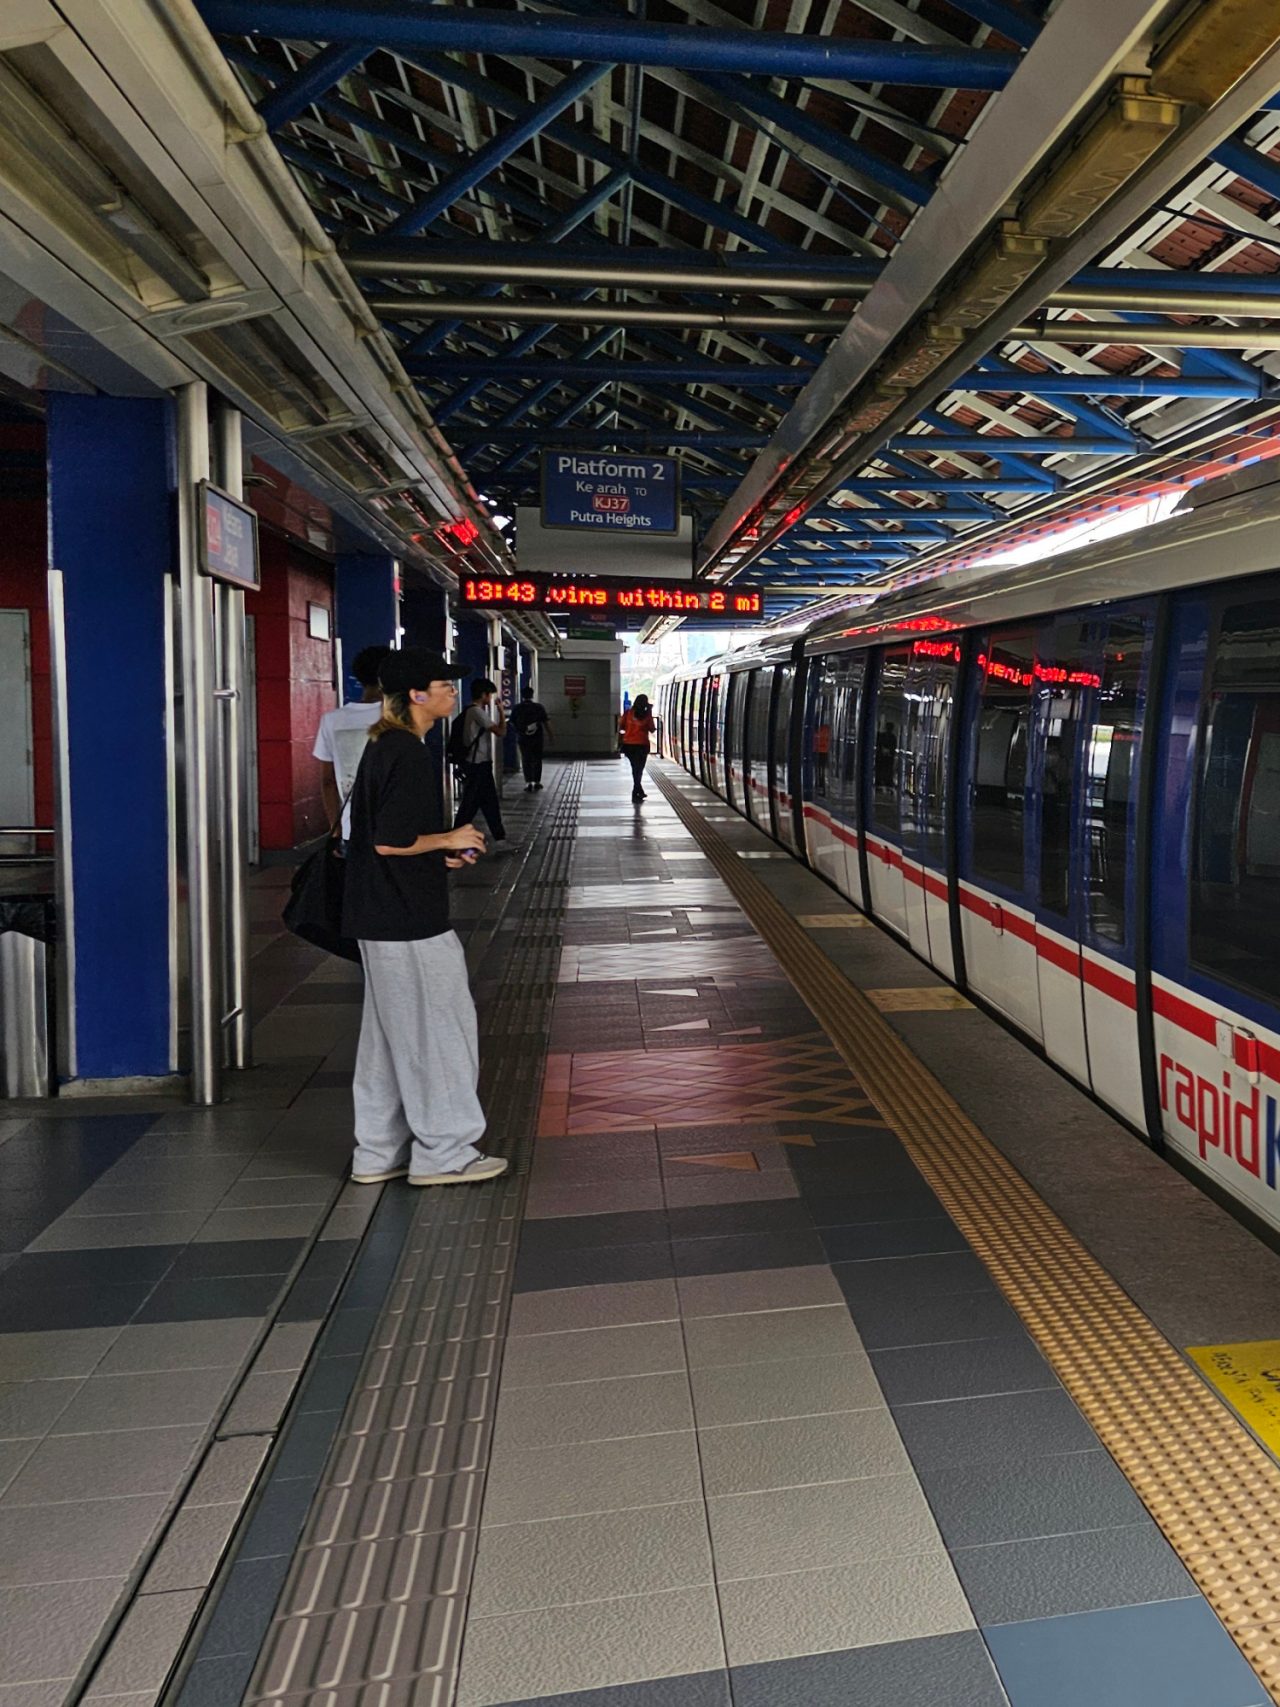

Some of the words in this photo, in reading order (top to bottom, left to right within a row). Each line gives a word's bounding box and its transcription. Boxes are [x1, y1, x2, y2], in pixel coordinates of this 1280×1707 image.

[557, 456, 646, 479] Platform
[652, 463, 665, 481] 2
[575, 480, 594, 493] Ke
[596, 483, 627, 495] arah
[634, 486, 648, 497] TO
[594, 497, 630, 510] KJ37
[570, 509, 603, 523] Putra
[606, 512, 652, 528] Heights
[465, 580, 536, 603] 13:43
[616, 588, 699, 610] within
[711, 592, 725, 610] 2
